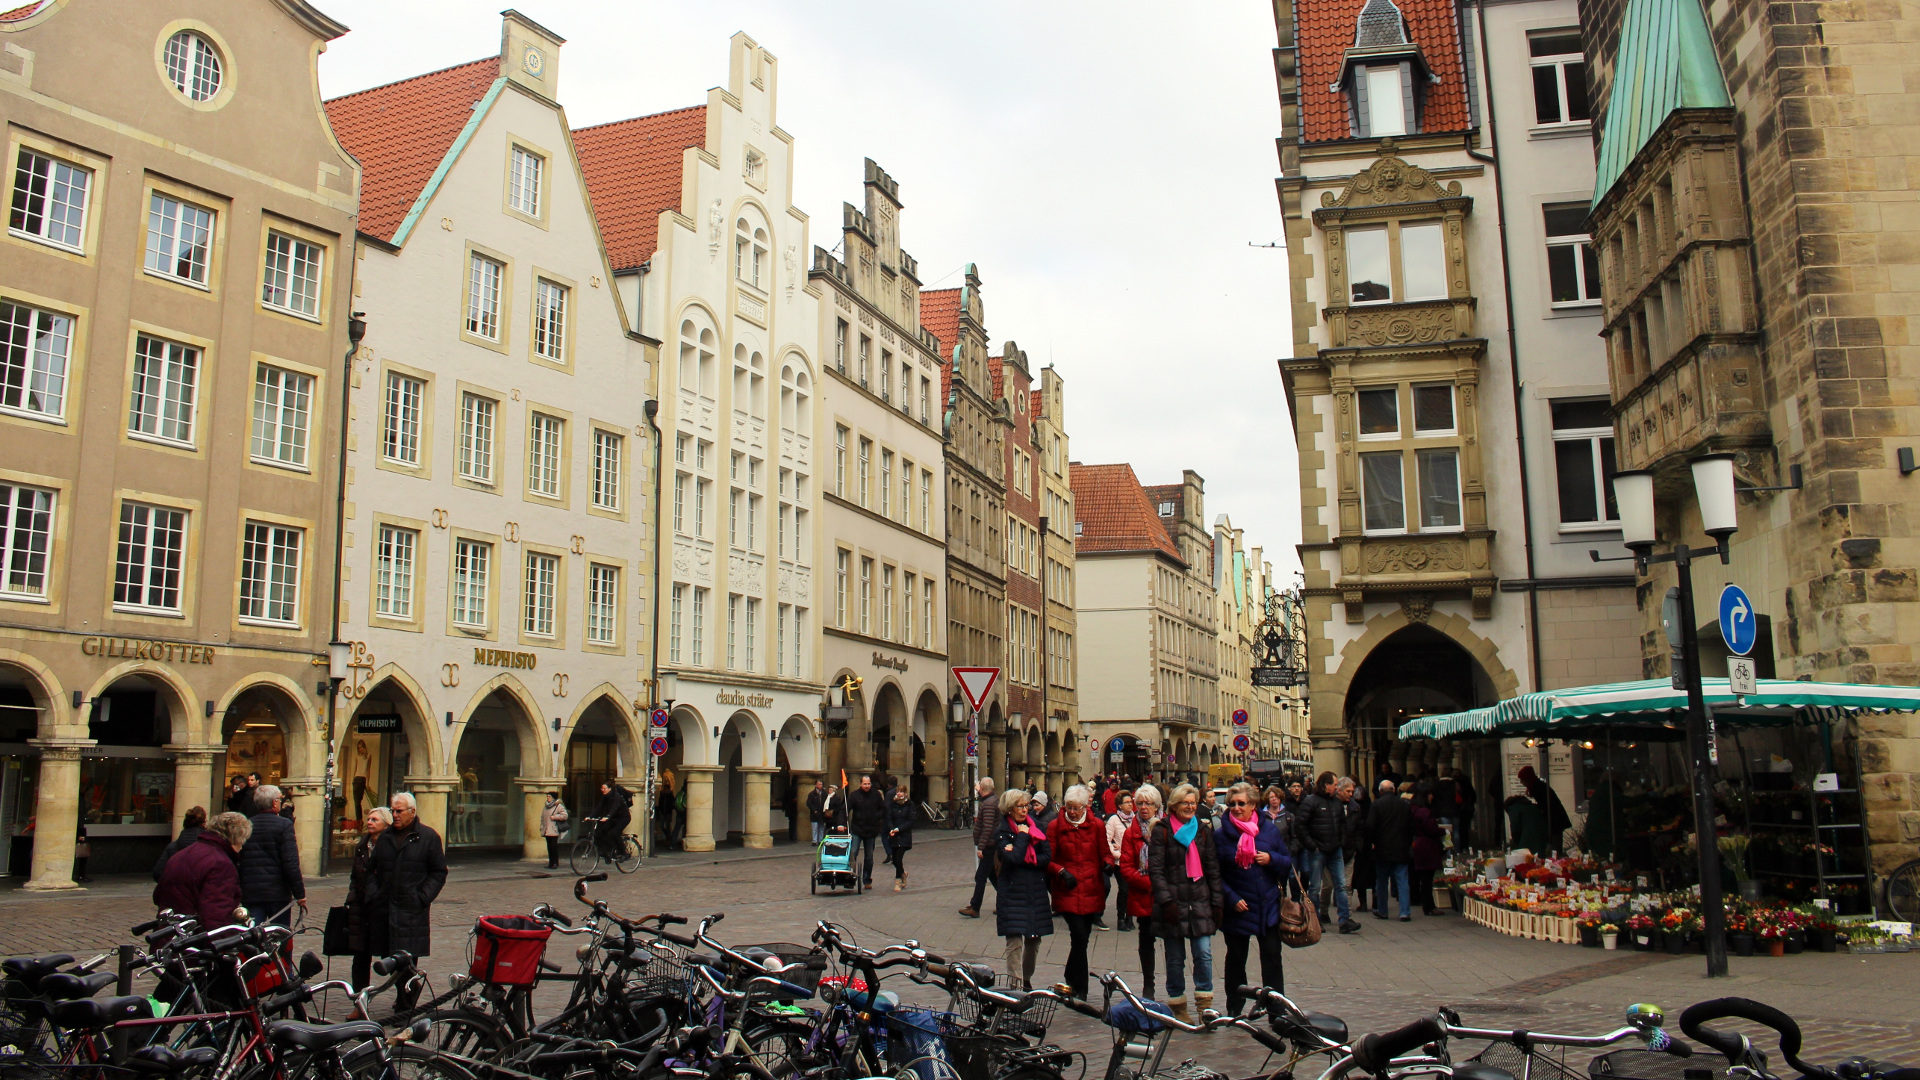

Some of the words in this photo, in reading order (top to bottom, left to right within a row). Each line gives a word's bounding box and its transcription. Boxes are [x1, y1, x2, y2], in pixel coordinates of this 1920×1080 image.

[82, 637, 216, 664] GILLKÖTTER
[473, 647, 537, 670] MEPHISTO
[716, 688, 745, 706] claudia
[746, 692, 774, 709] sträter
[360, 719, 389, 728] MEPHISTO
